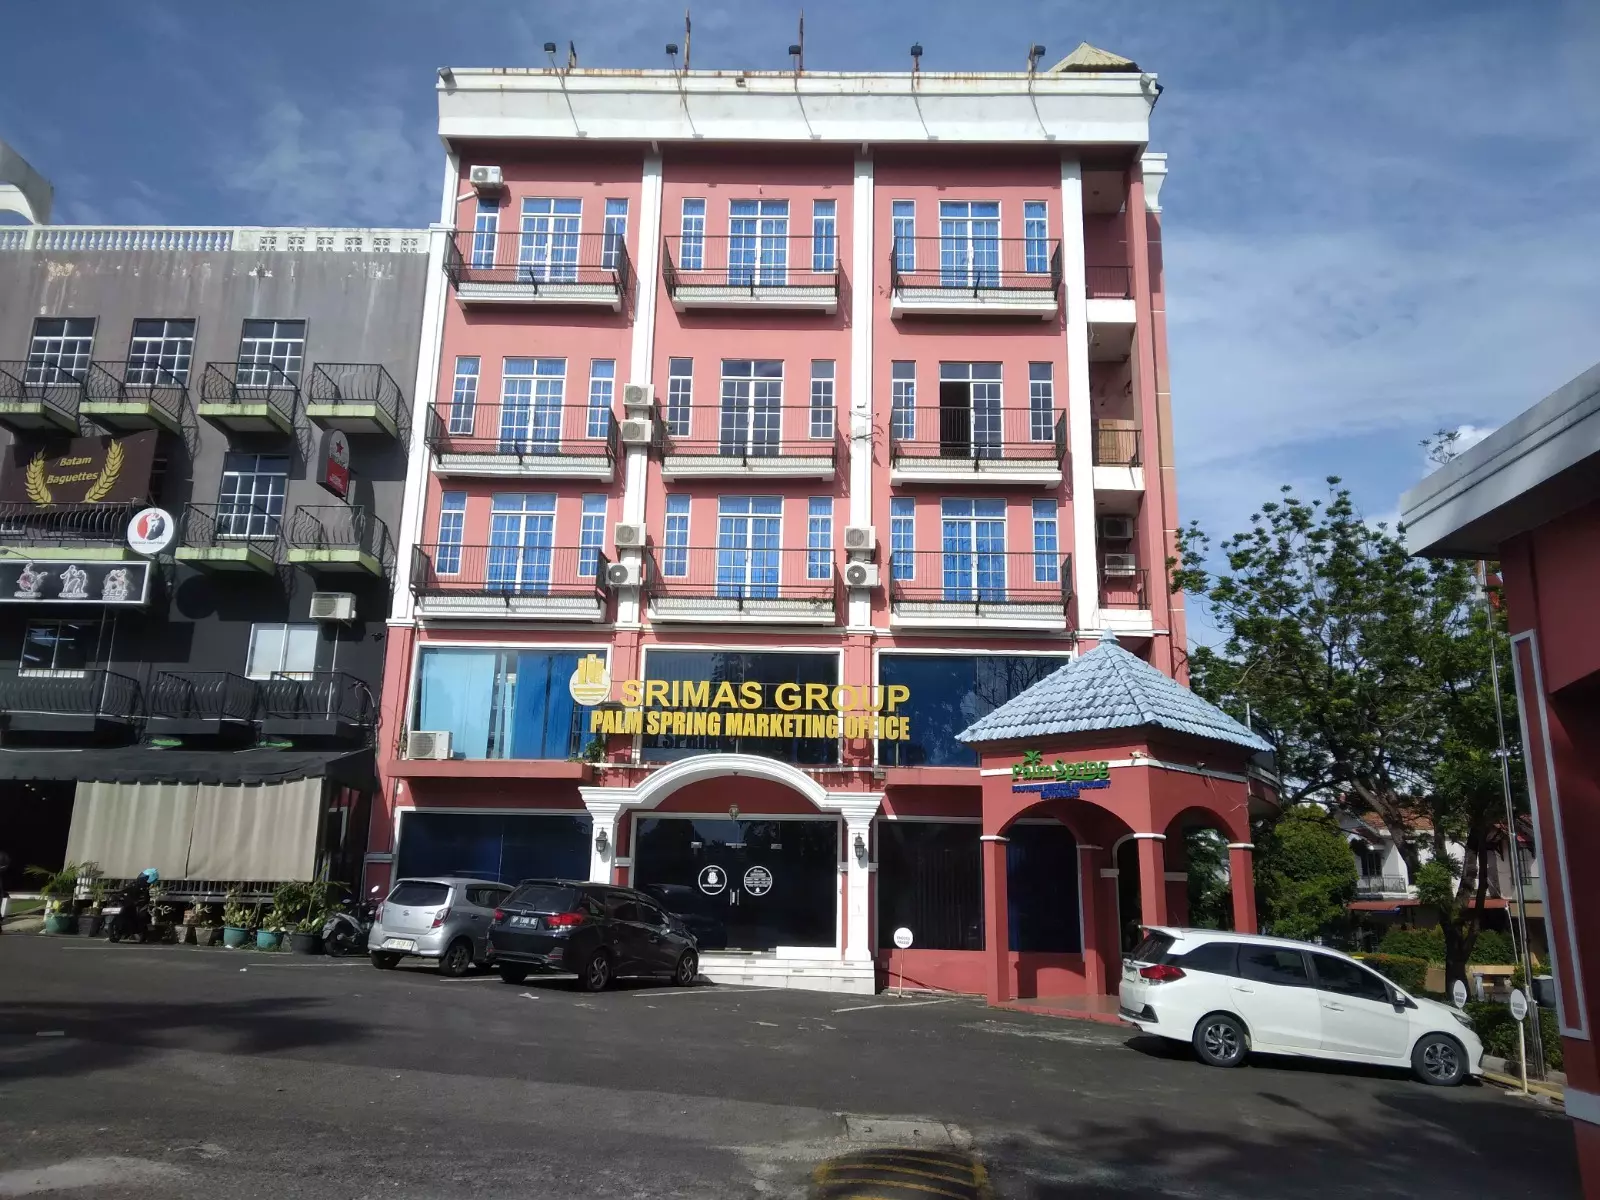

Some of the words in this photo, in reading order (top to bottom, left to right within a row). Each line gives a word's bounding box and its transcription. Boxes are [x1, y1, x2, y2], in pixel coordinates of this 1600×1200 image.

[59, 456, 92, 467] Batam
[46, 472, 99, 485] Baguettes
[620, 679, 764, 709] SRIMAS
[774, 682, 911, 712] GROUP
[589, 710, 643, 735] PALM
[646, 712, 721, 737] SPRING
[726, 713, 839, 739] MARKETING
[844, 716, 911, 741] OFFICE
[1012, 761, 1054, 780] Palm
[1055, 758, 1110, 781] Spring
